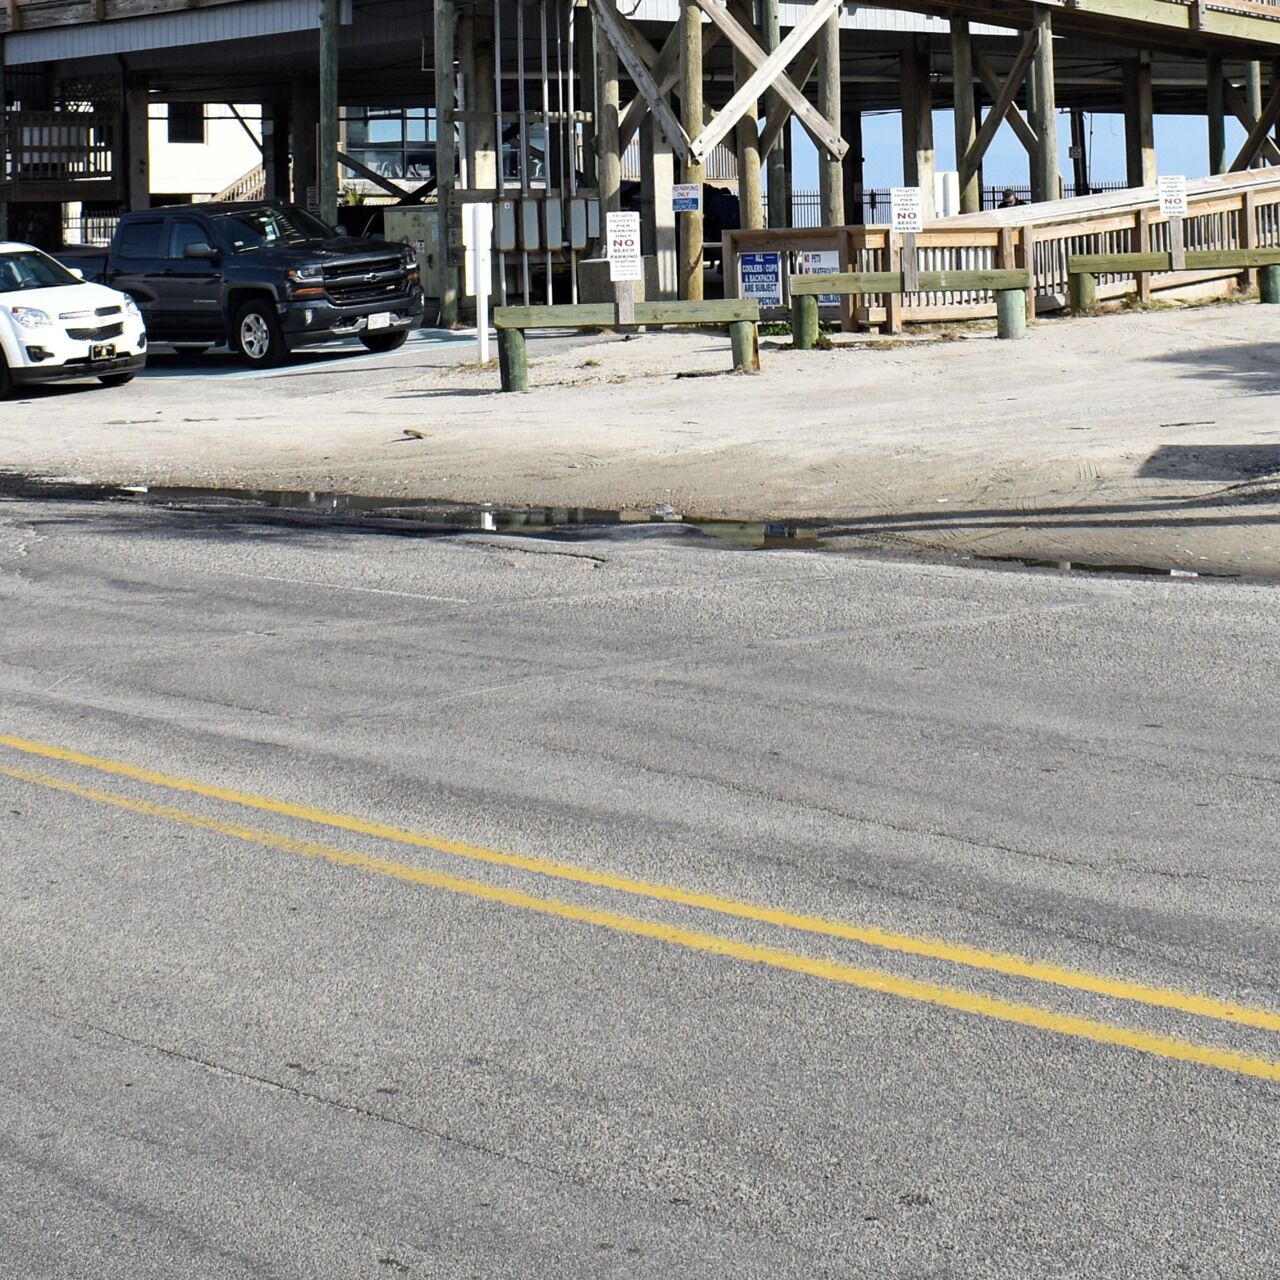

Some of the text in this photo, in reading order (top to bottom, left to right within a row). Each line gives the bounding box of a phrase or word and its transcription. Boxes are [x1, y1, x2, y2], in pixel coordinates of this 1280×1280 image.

[804, 254, 822, 262] NO PETS
[742, 264, 762, 272] COOLERS
[766, 264, 778, 272] CUPS
[750, 274, 776, 282] BACKPACKS
[744, 284, 776, 292] ARE SUBJECT
